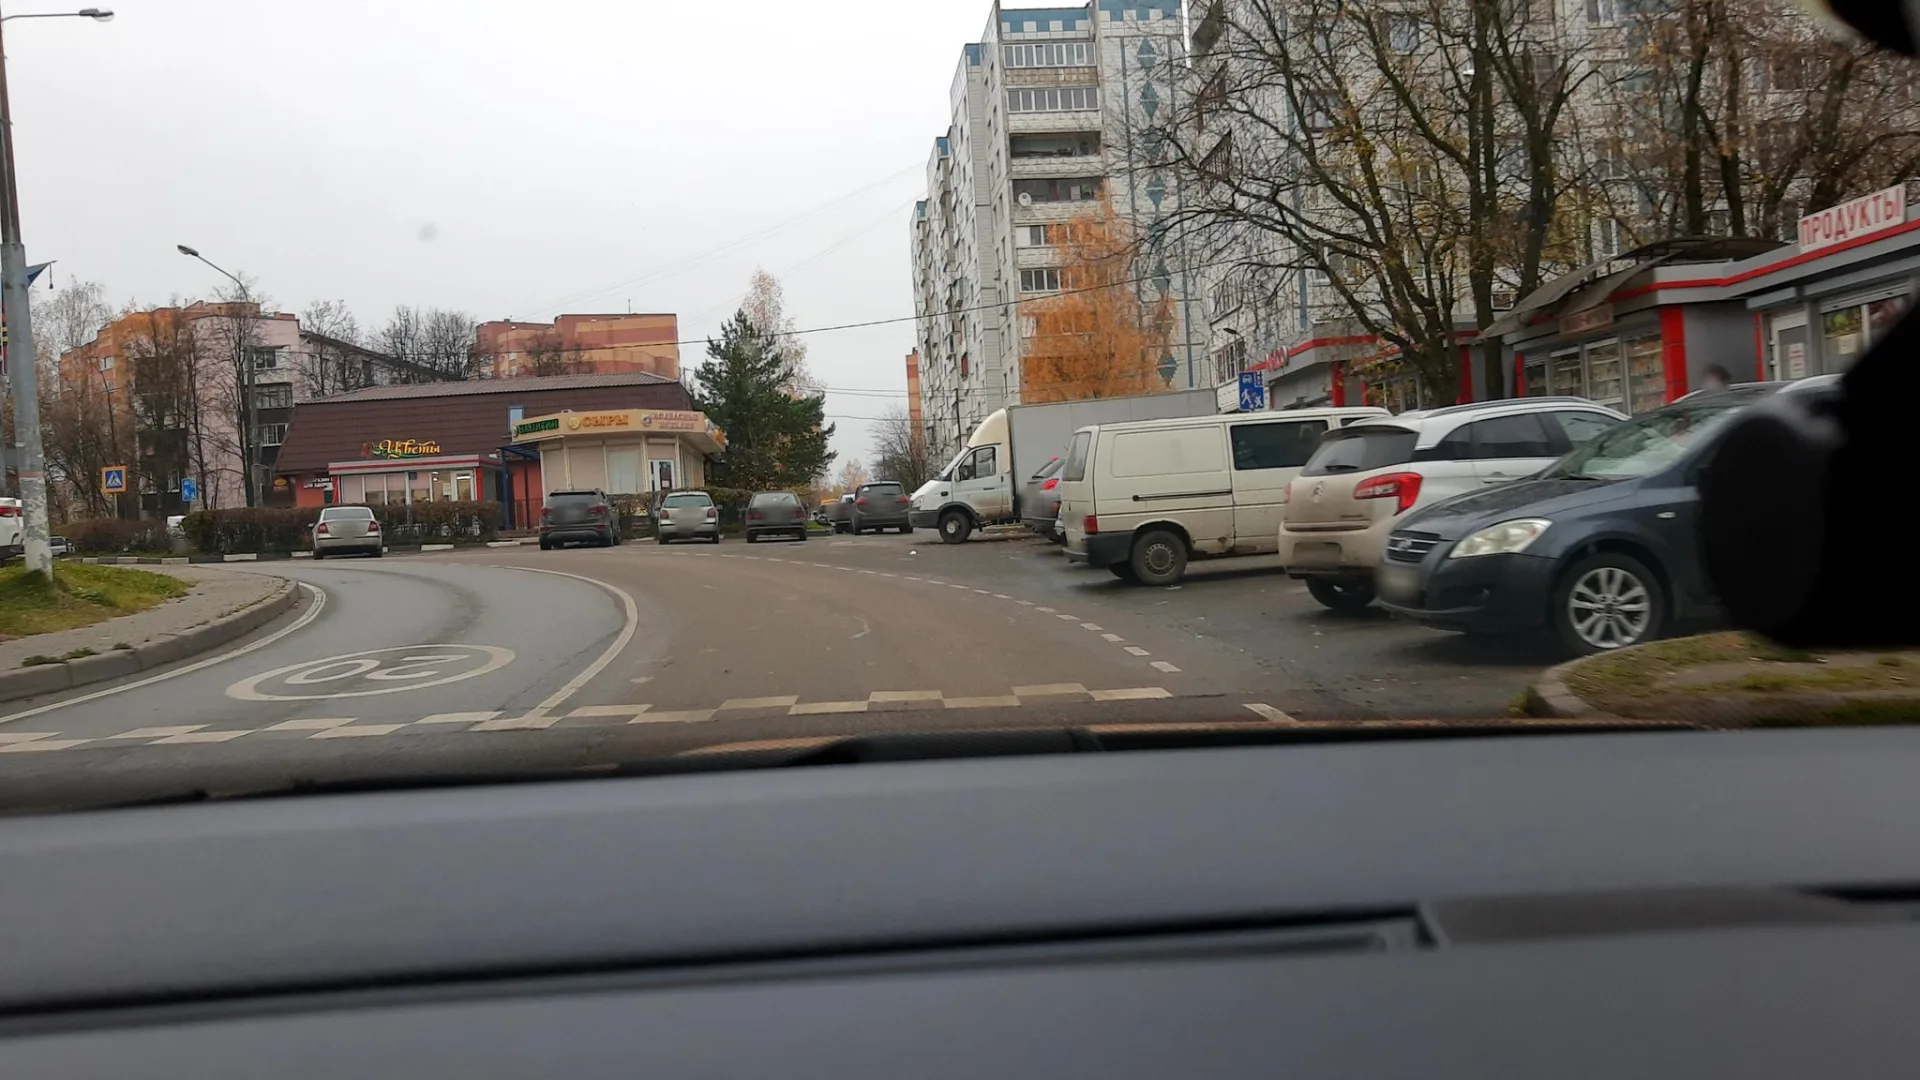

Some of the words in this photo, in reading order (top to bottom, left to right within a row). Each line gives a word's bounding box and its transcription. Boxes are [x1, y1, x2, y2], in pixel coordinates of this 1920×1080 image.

[1800, 188, 1900, 246] ПРОДУКТЫ
[582, 414, 629, 428] СЫРЫ
[379, 438, 441, 459] Цветы
